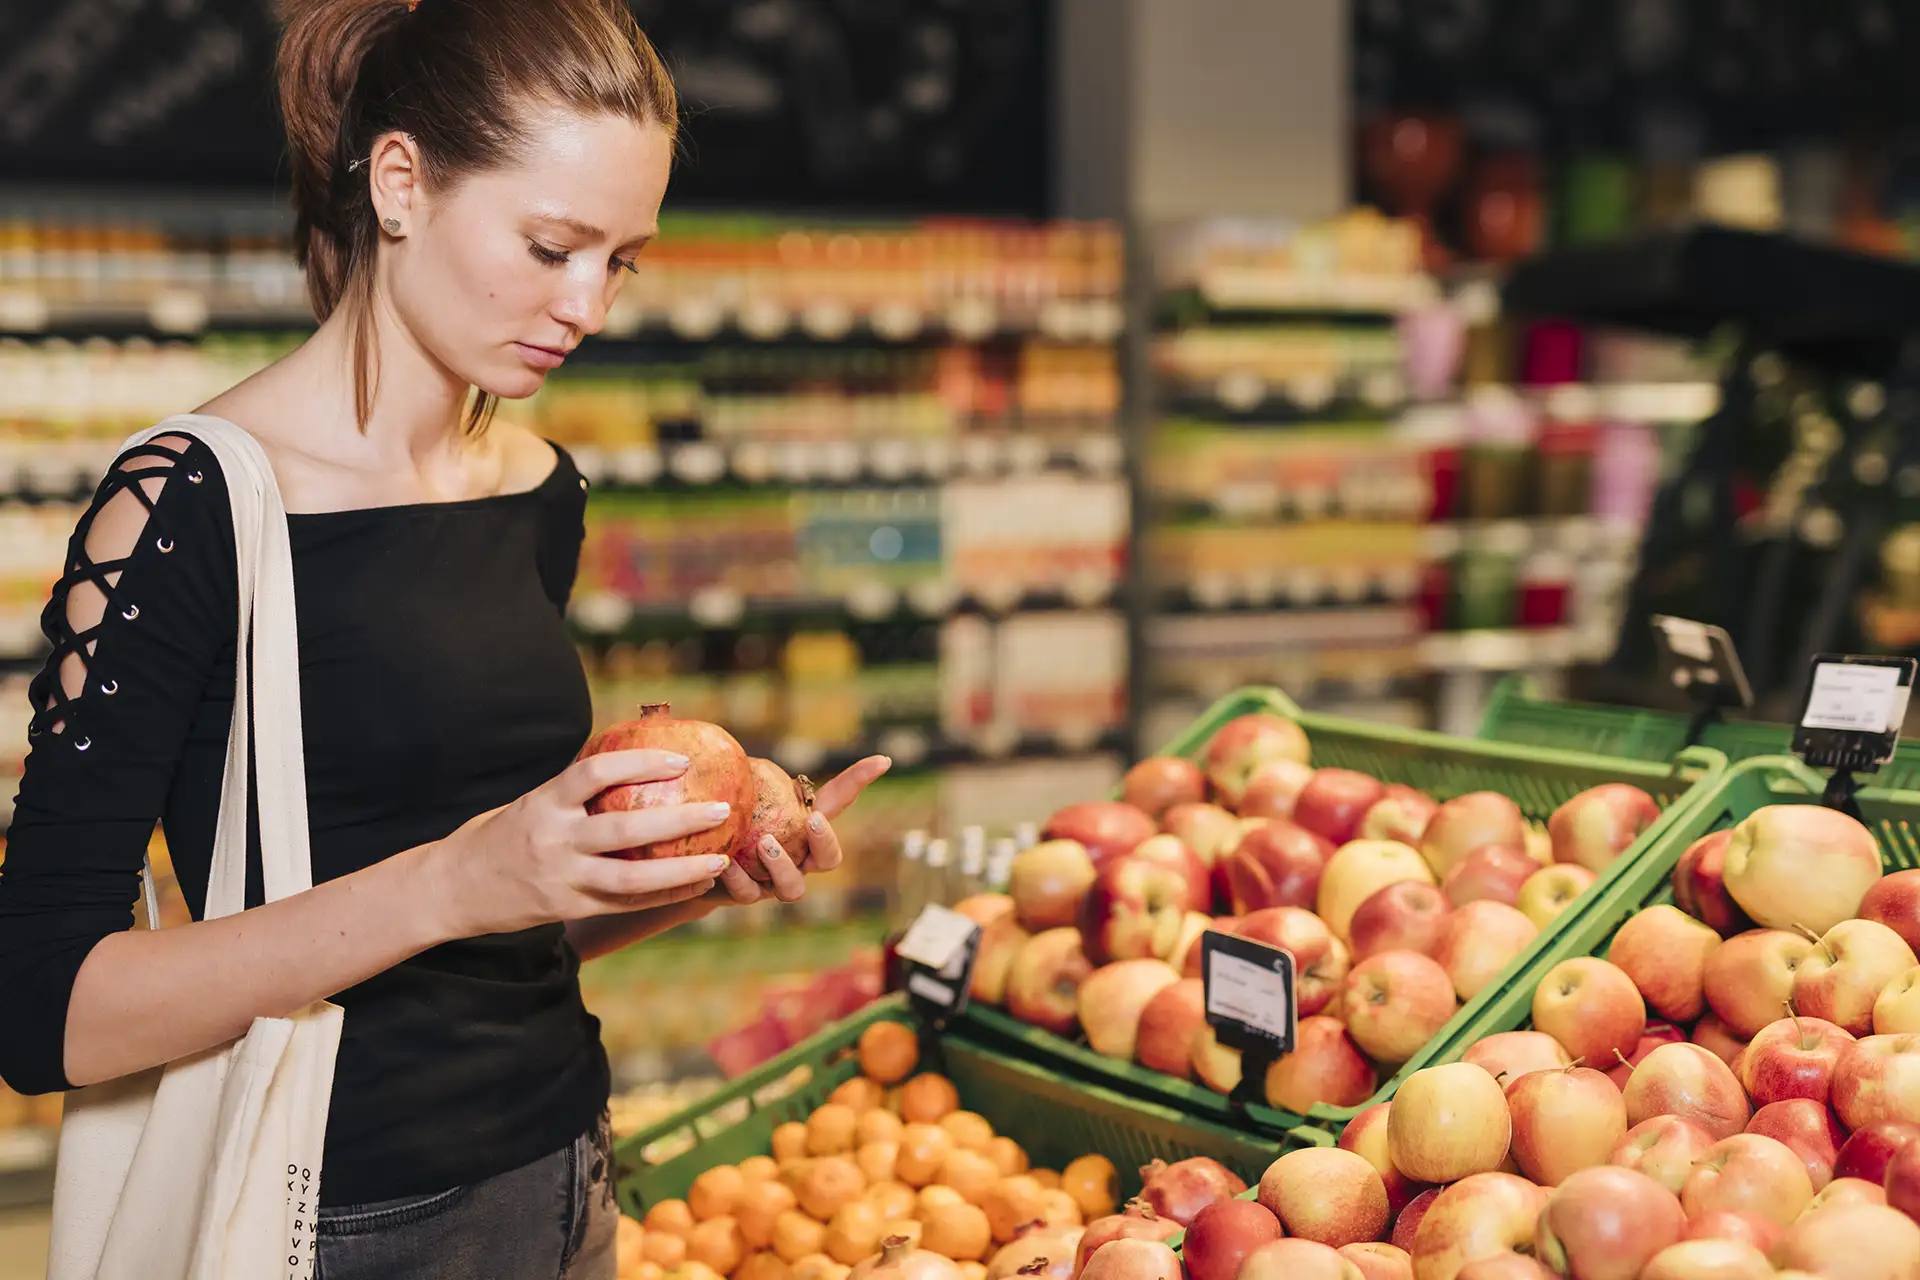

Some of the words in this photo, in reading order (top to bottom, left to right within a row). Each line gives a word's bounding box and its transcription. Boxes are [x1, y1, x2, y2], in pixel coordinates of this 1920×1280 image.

[288, 1164, 297, 1175] O
[302, 1168, 310, 1181] Q
[301, 1184, 308, 1194] Y
[298, 1202, 306, 1213] Z
[294, 1219, 303, 1230] R
[292, 1238, 301, 1248] V
[288, 1255, 299, 1266] O
